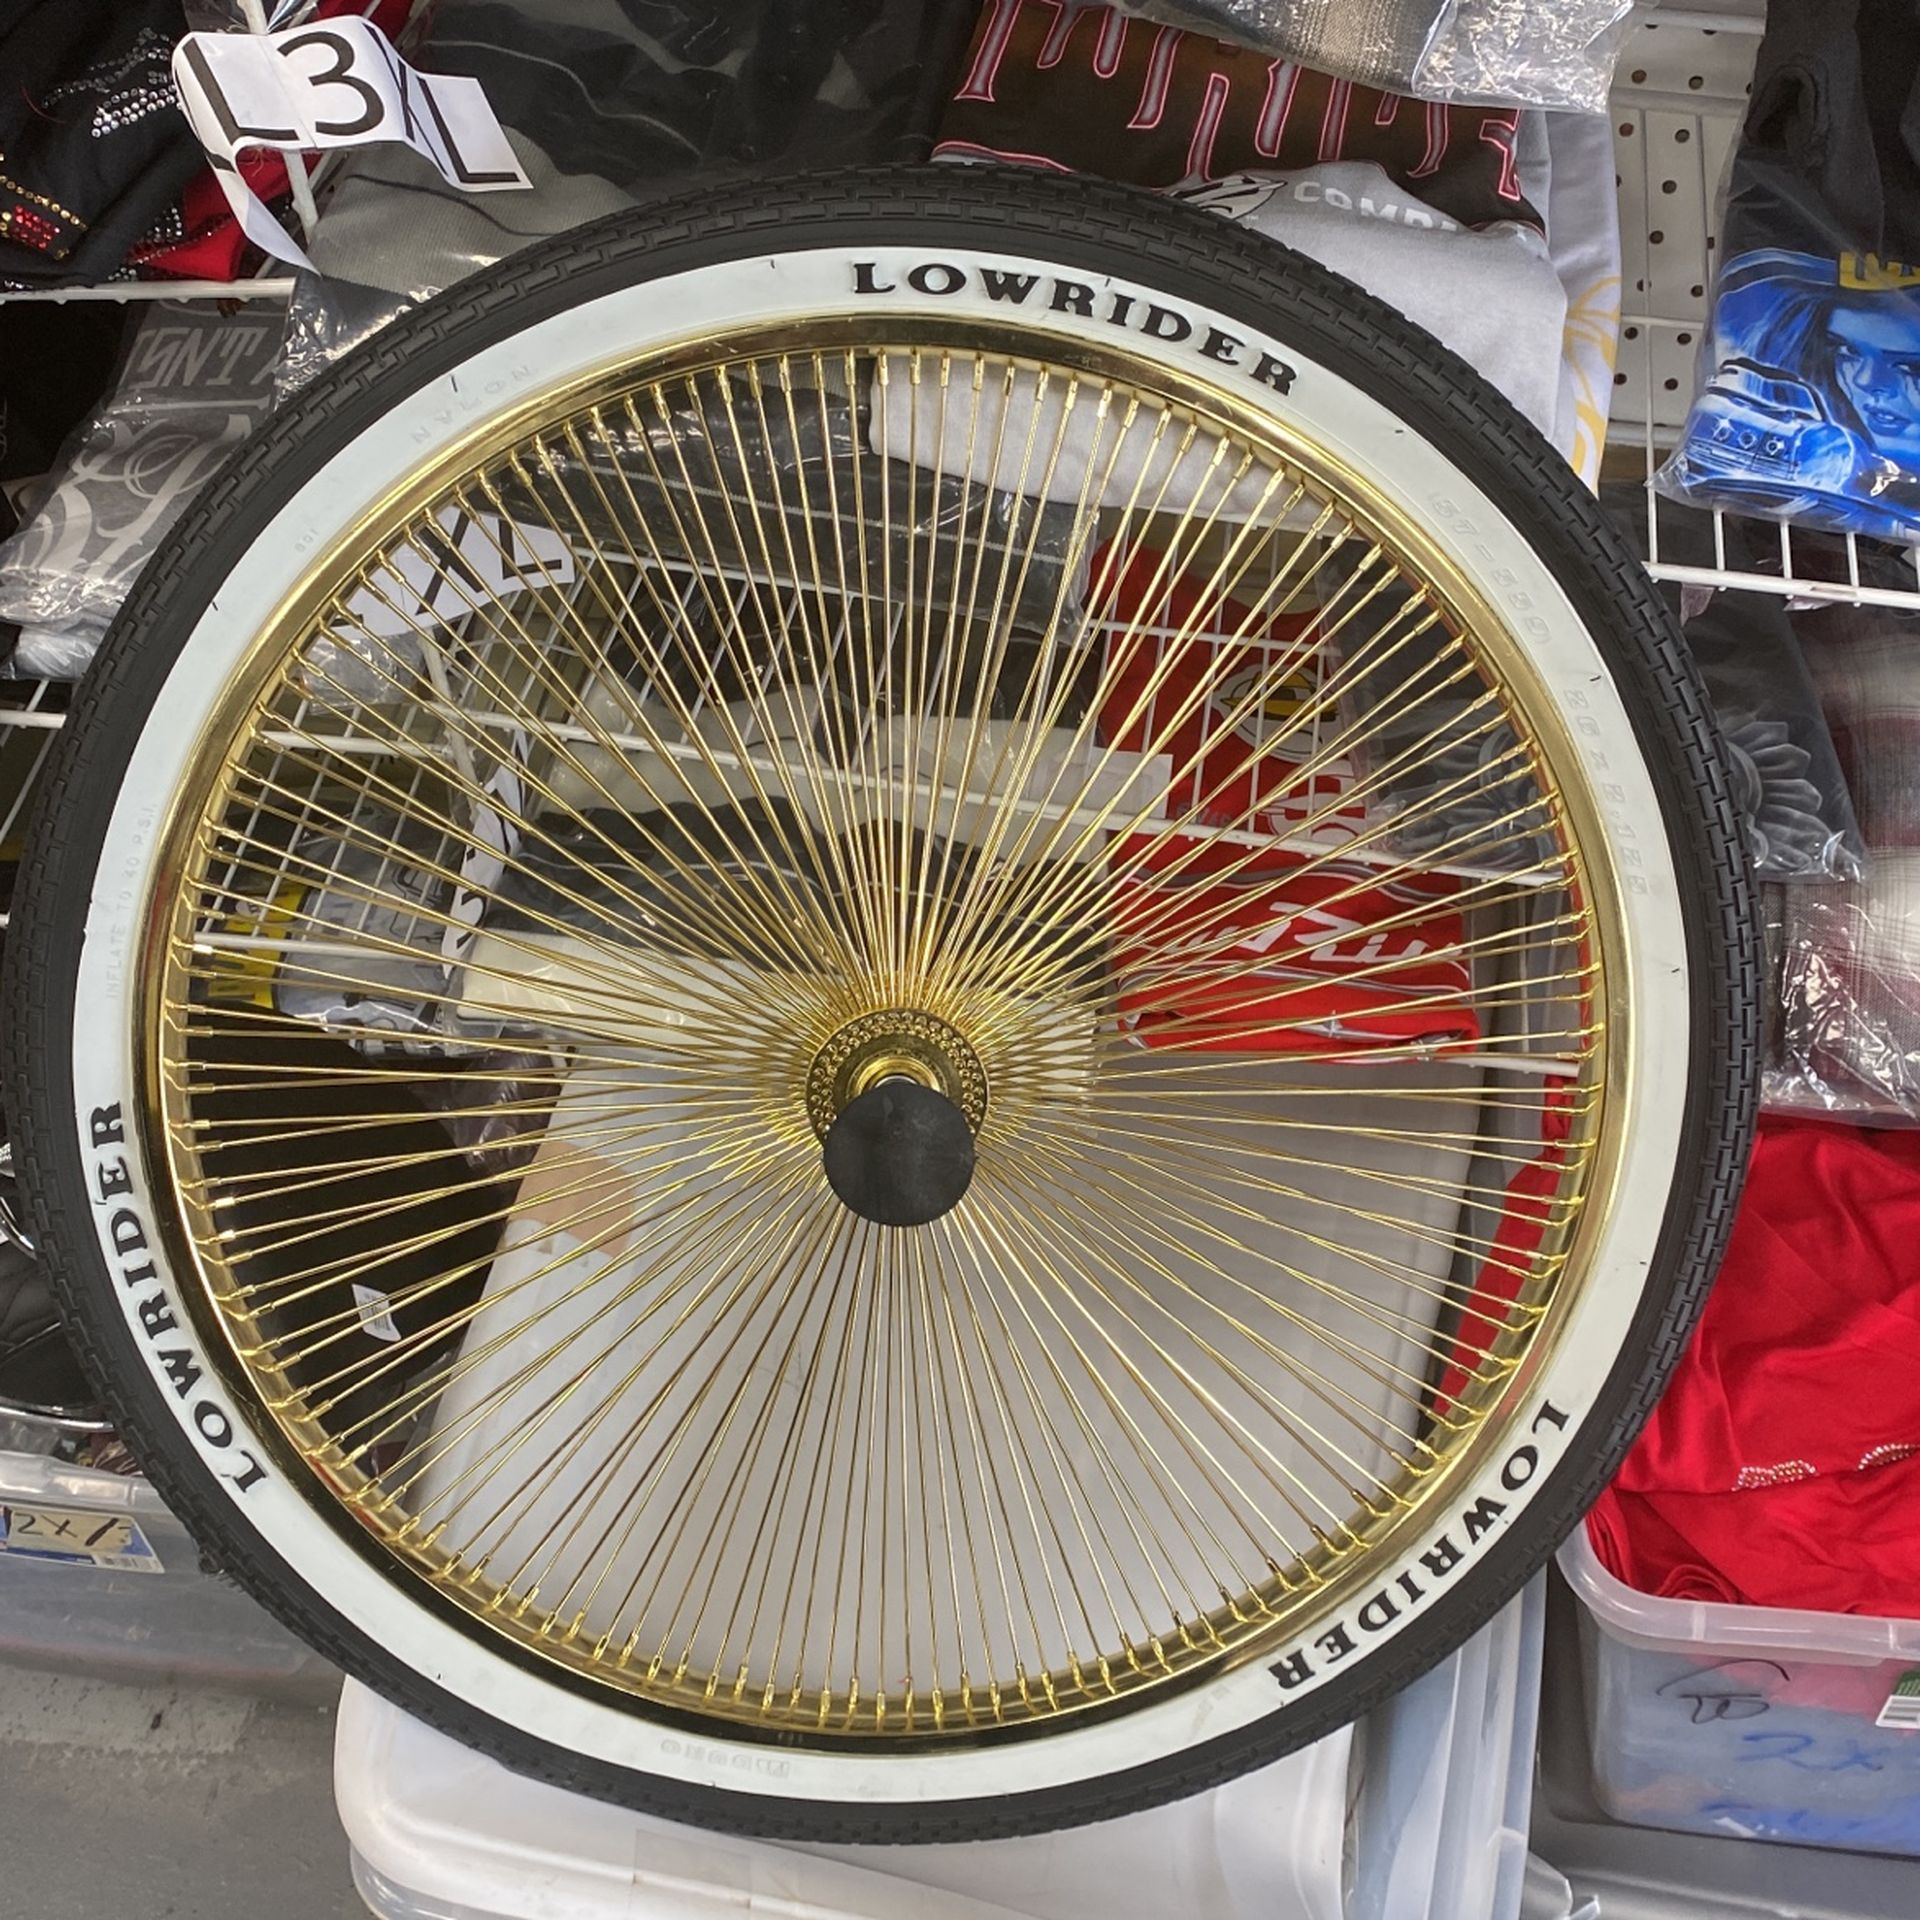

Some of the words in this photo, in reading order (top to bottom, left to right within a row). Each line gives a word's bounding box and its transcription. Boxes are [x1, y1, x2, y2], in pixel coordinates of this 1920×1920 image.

[853, 262, 1298, 396] LOWRIDER
[90, 1101, 271, 1494] LOWRIDER
[1267, 1399, 1570, 1690] LOWRIDER
